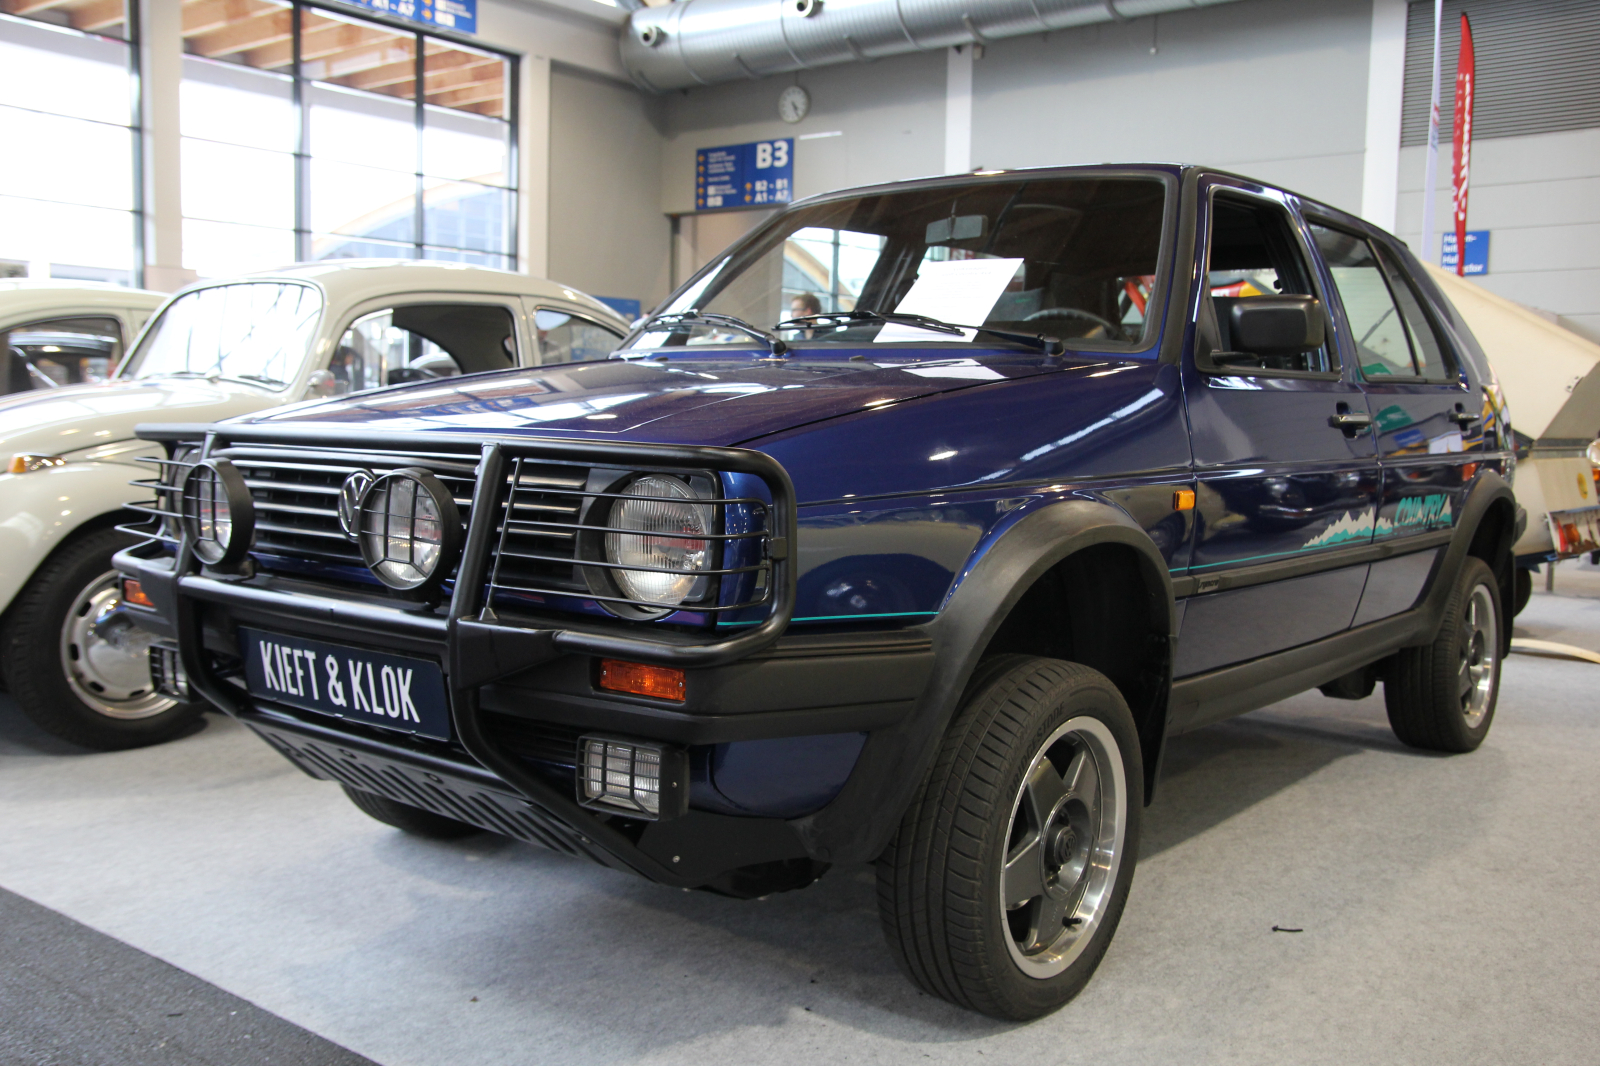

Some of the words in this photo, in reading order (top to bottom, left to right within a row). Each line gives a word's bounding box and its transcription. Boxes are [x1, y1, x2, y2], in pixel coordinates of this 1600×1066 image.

[756, 140, 789, 169] B3
[754, 191, 768, 203] A1
[755, 180, 768, 192] B2
[775, 178, 788, 190] B1
[1394, 493, 1447, 528] COUNTRY
[259, 640, 319, 700] KIEFT
[325, 654, 347, 707] &
[348, 659, 420, 723] KLOK
